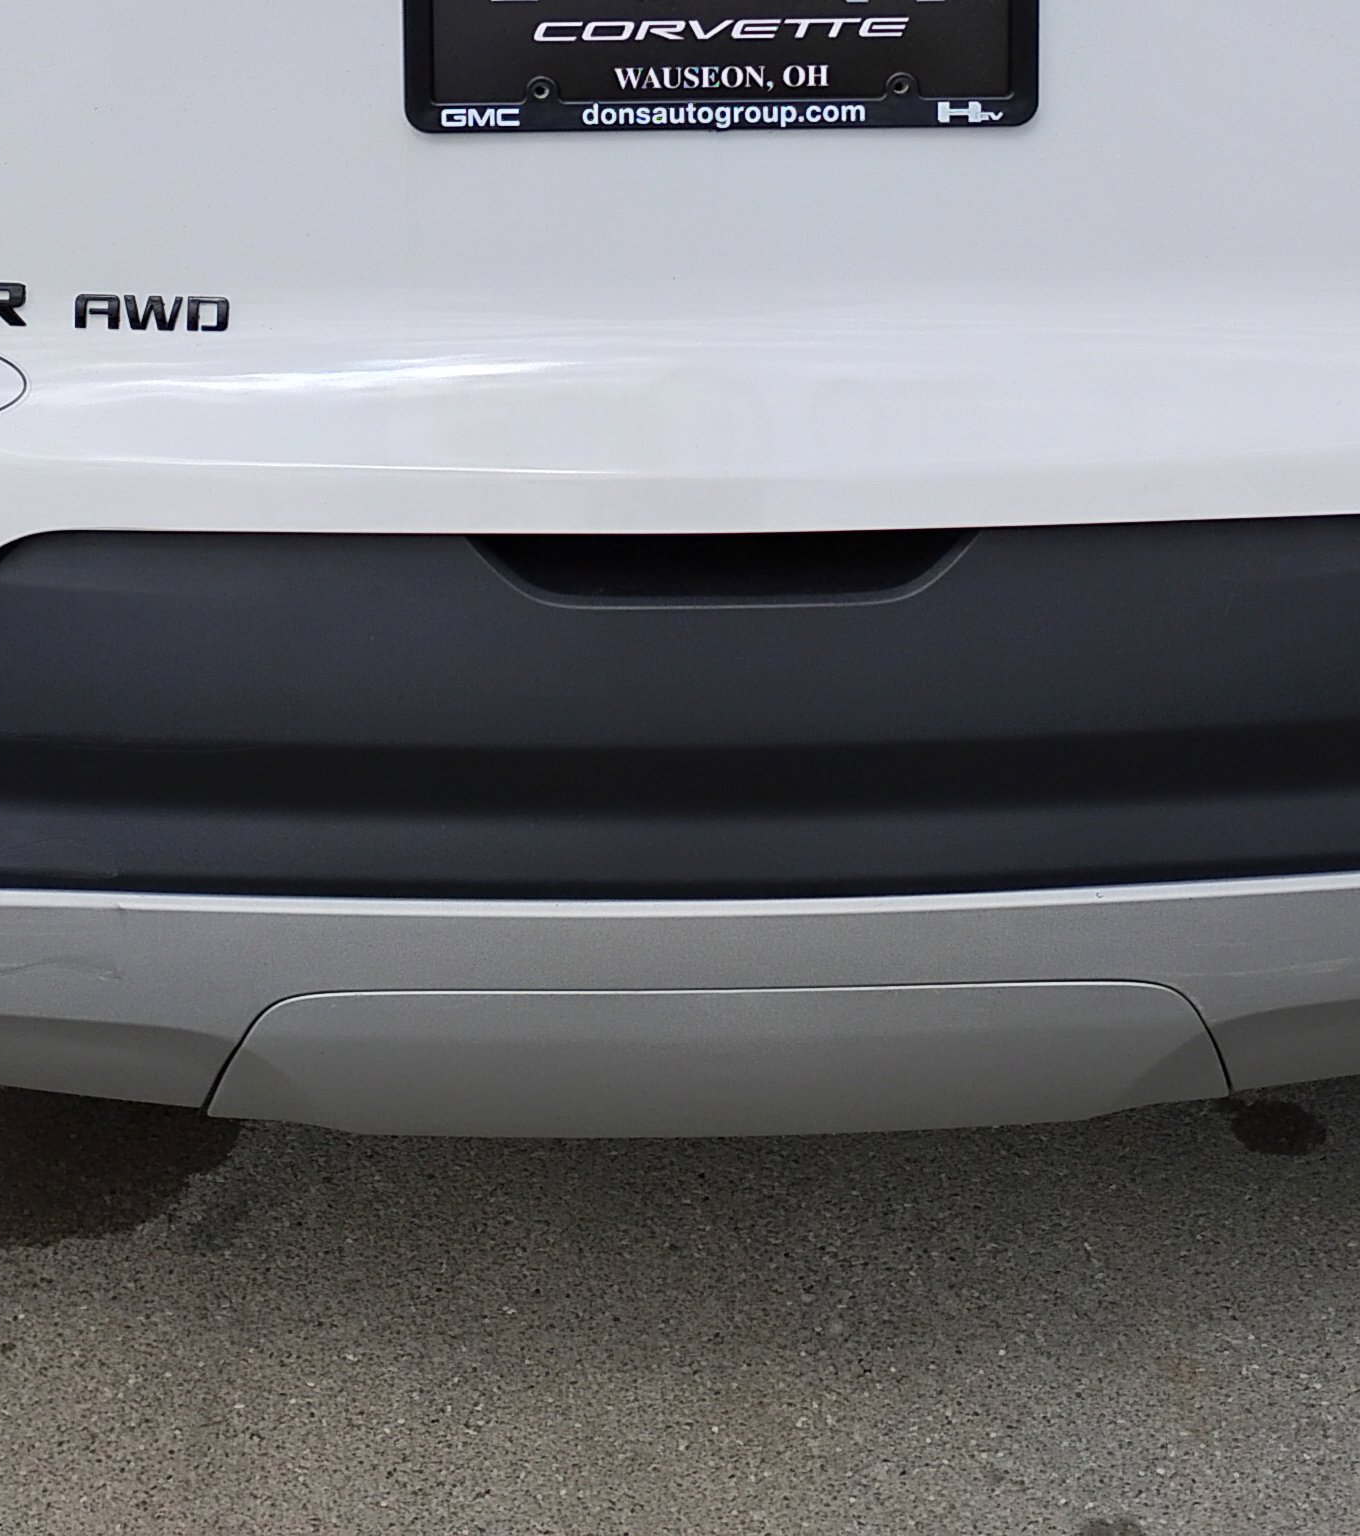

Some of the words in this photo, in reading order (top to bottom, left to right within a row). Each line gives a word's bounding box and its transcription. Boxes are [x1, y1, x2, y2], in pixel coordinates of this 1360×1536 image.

[532, 16, 910, 43] CORVETTE
[613, 65, 775, 92] WAUSEON,
[782, 64, 830, 87] OH
[440, 108, 521, 128] GMC
[582, 102, 867, 129] donsautogroup.com
[74, 292, 230, 332] AWD
